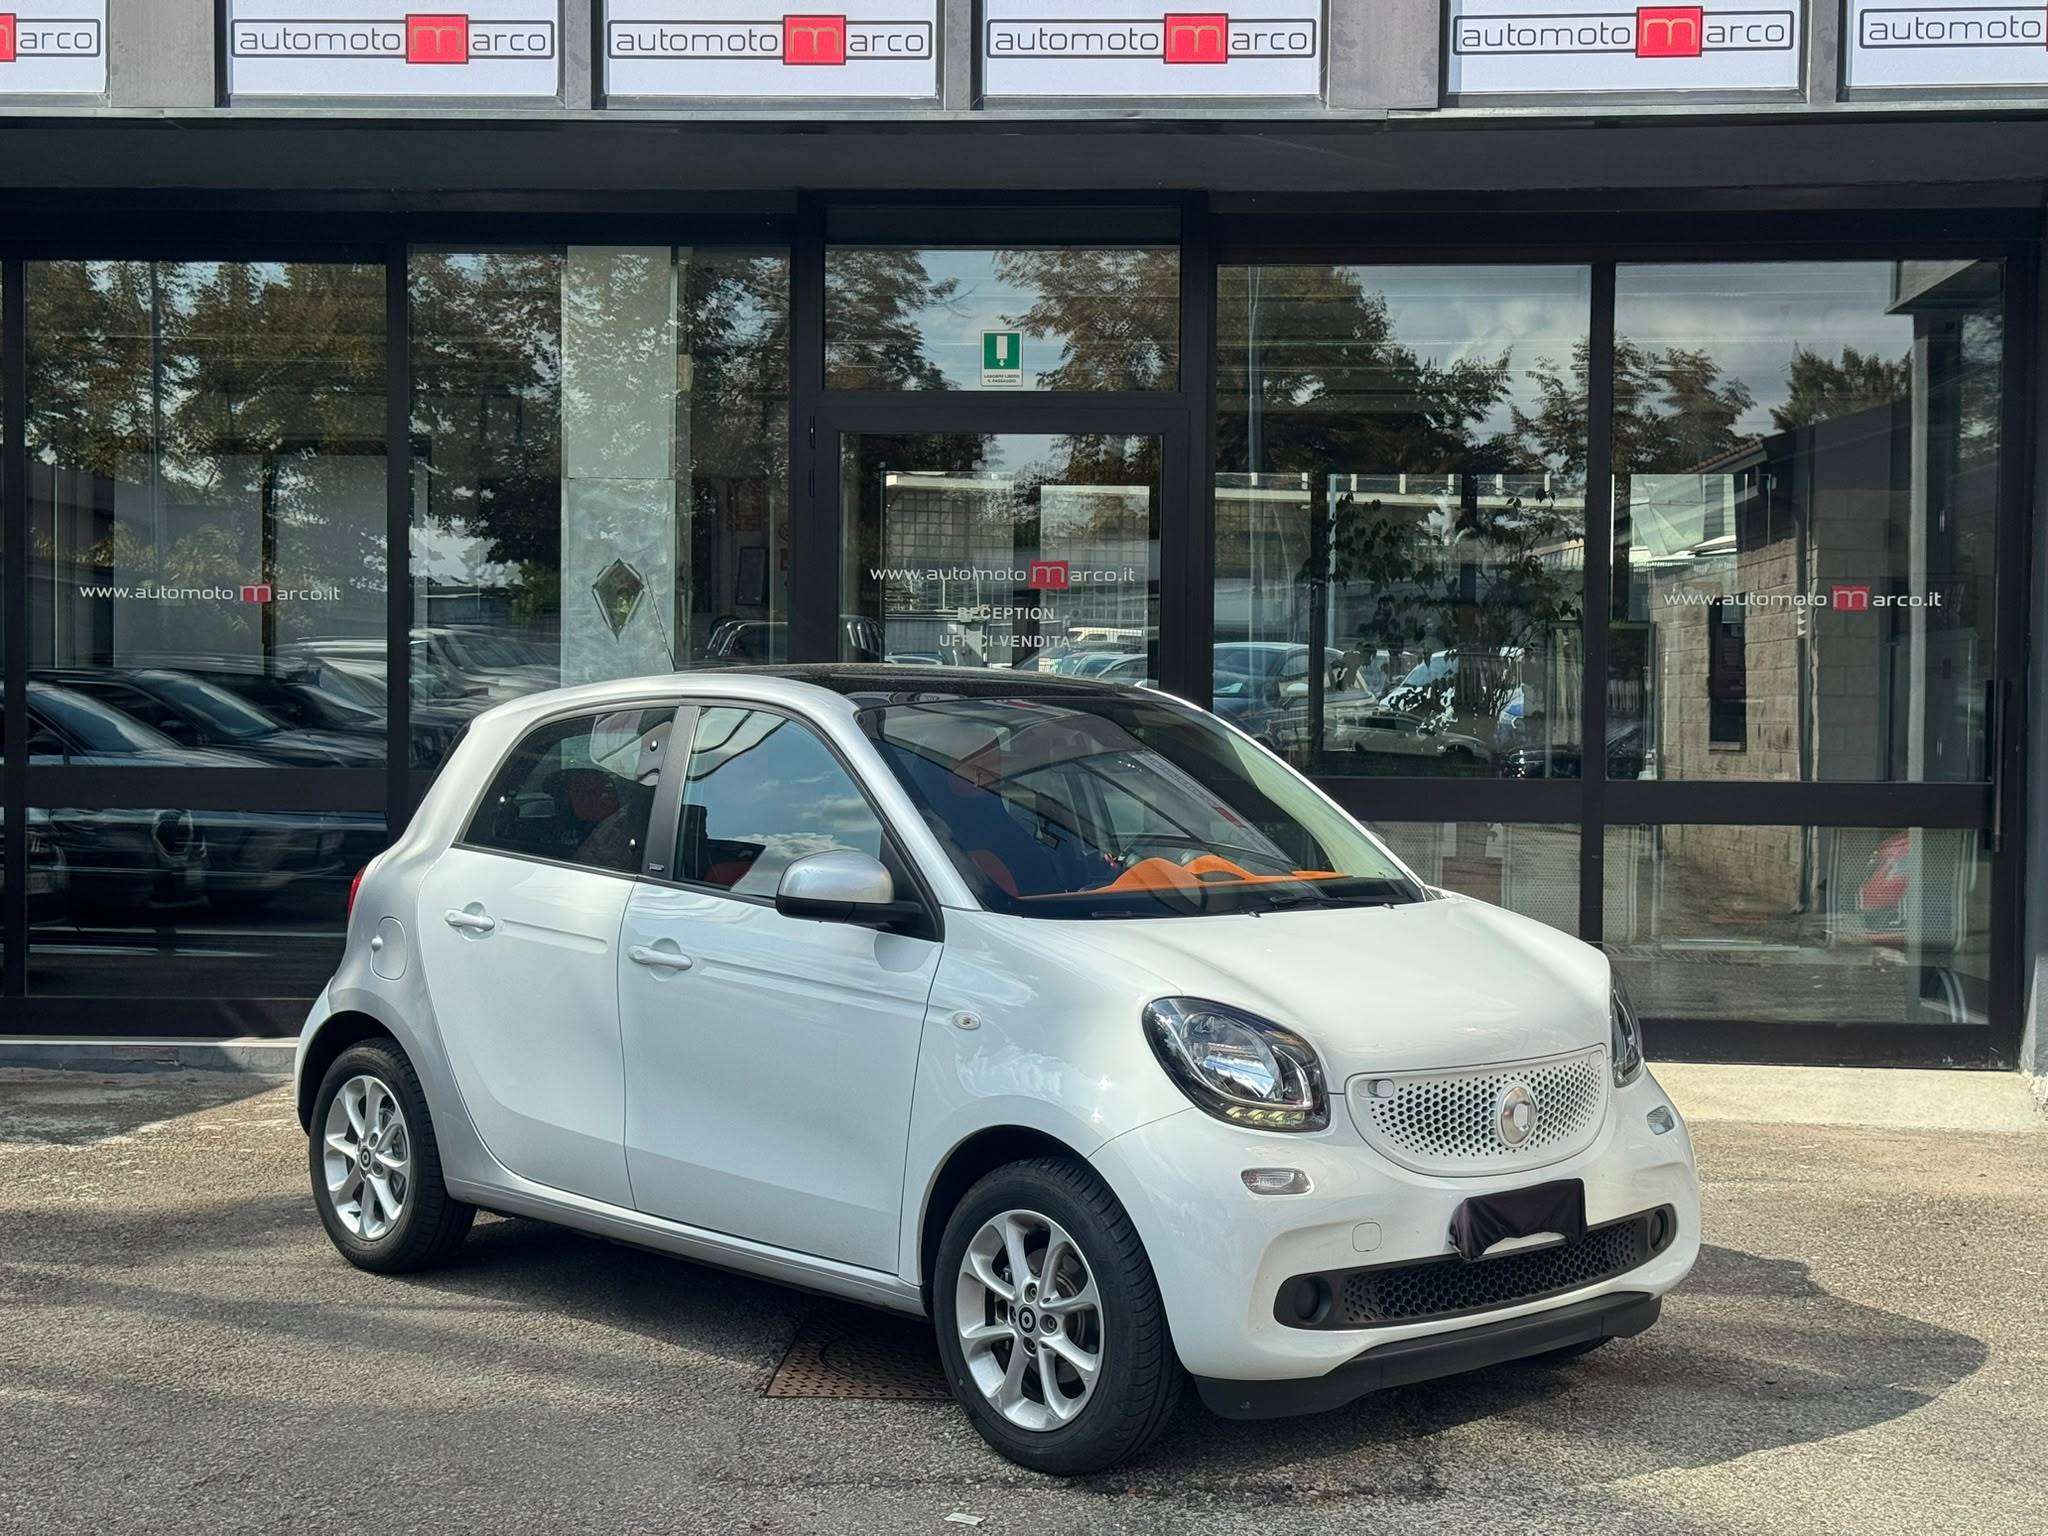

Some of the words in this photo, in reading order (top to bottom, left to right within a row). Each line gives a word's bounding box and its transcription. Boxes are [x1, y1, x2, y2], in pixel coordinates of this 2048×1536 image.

[1869, 15, 2042, 41] automoto
[79, 584, 341, 602] www.automotomarco.it
[1663, 589, 1942, 609] www.automotomarco.it
[1000, 635, 1071, 648] VENDITA
